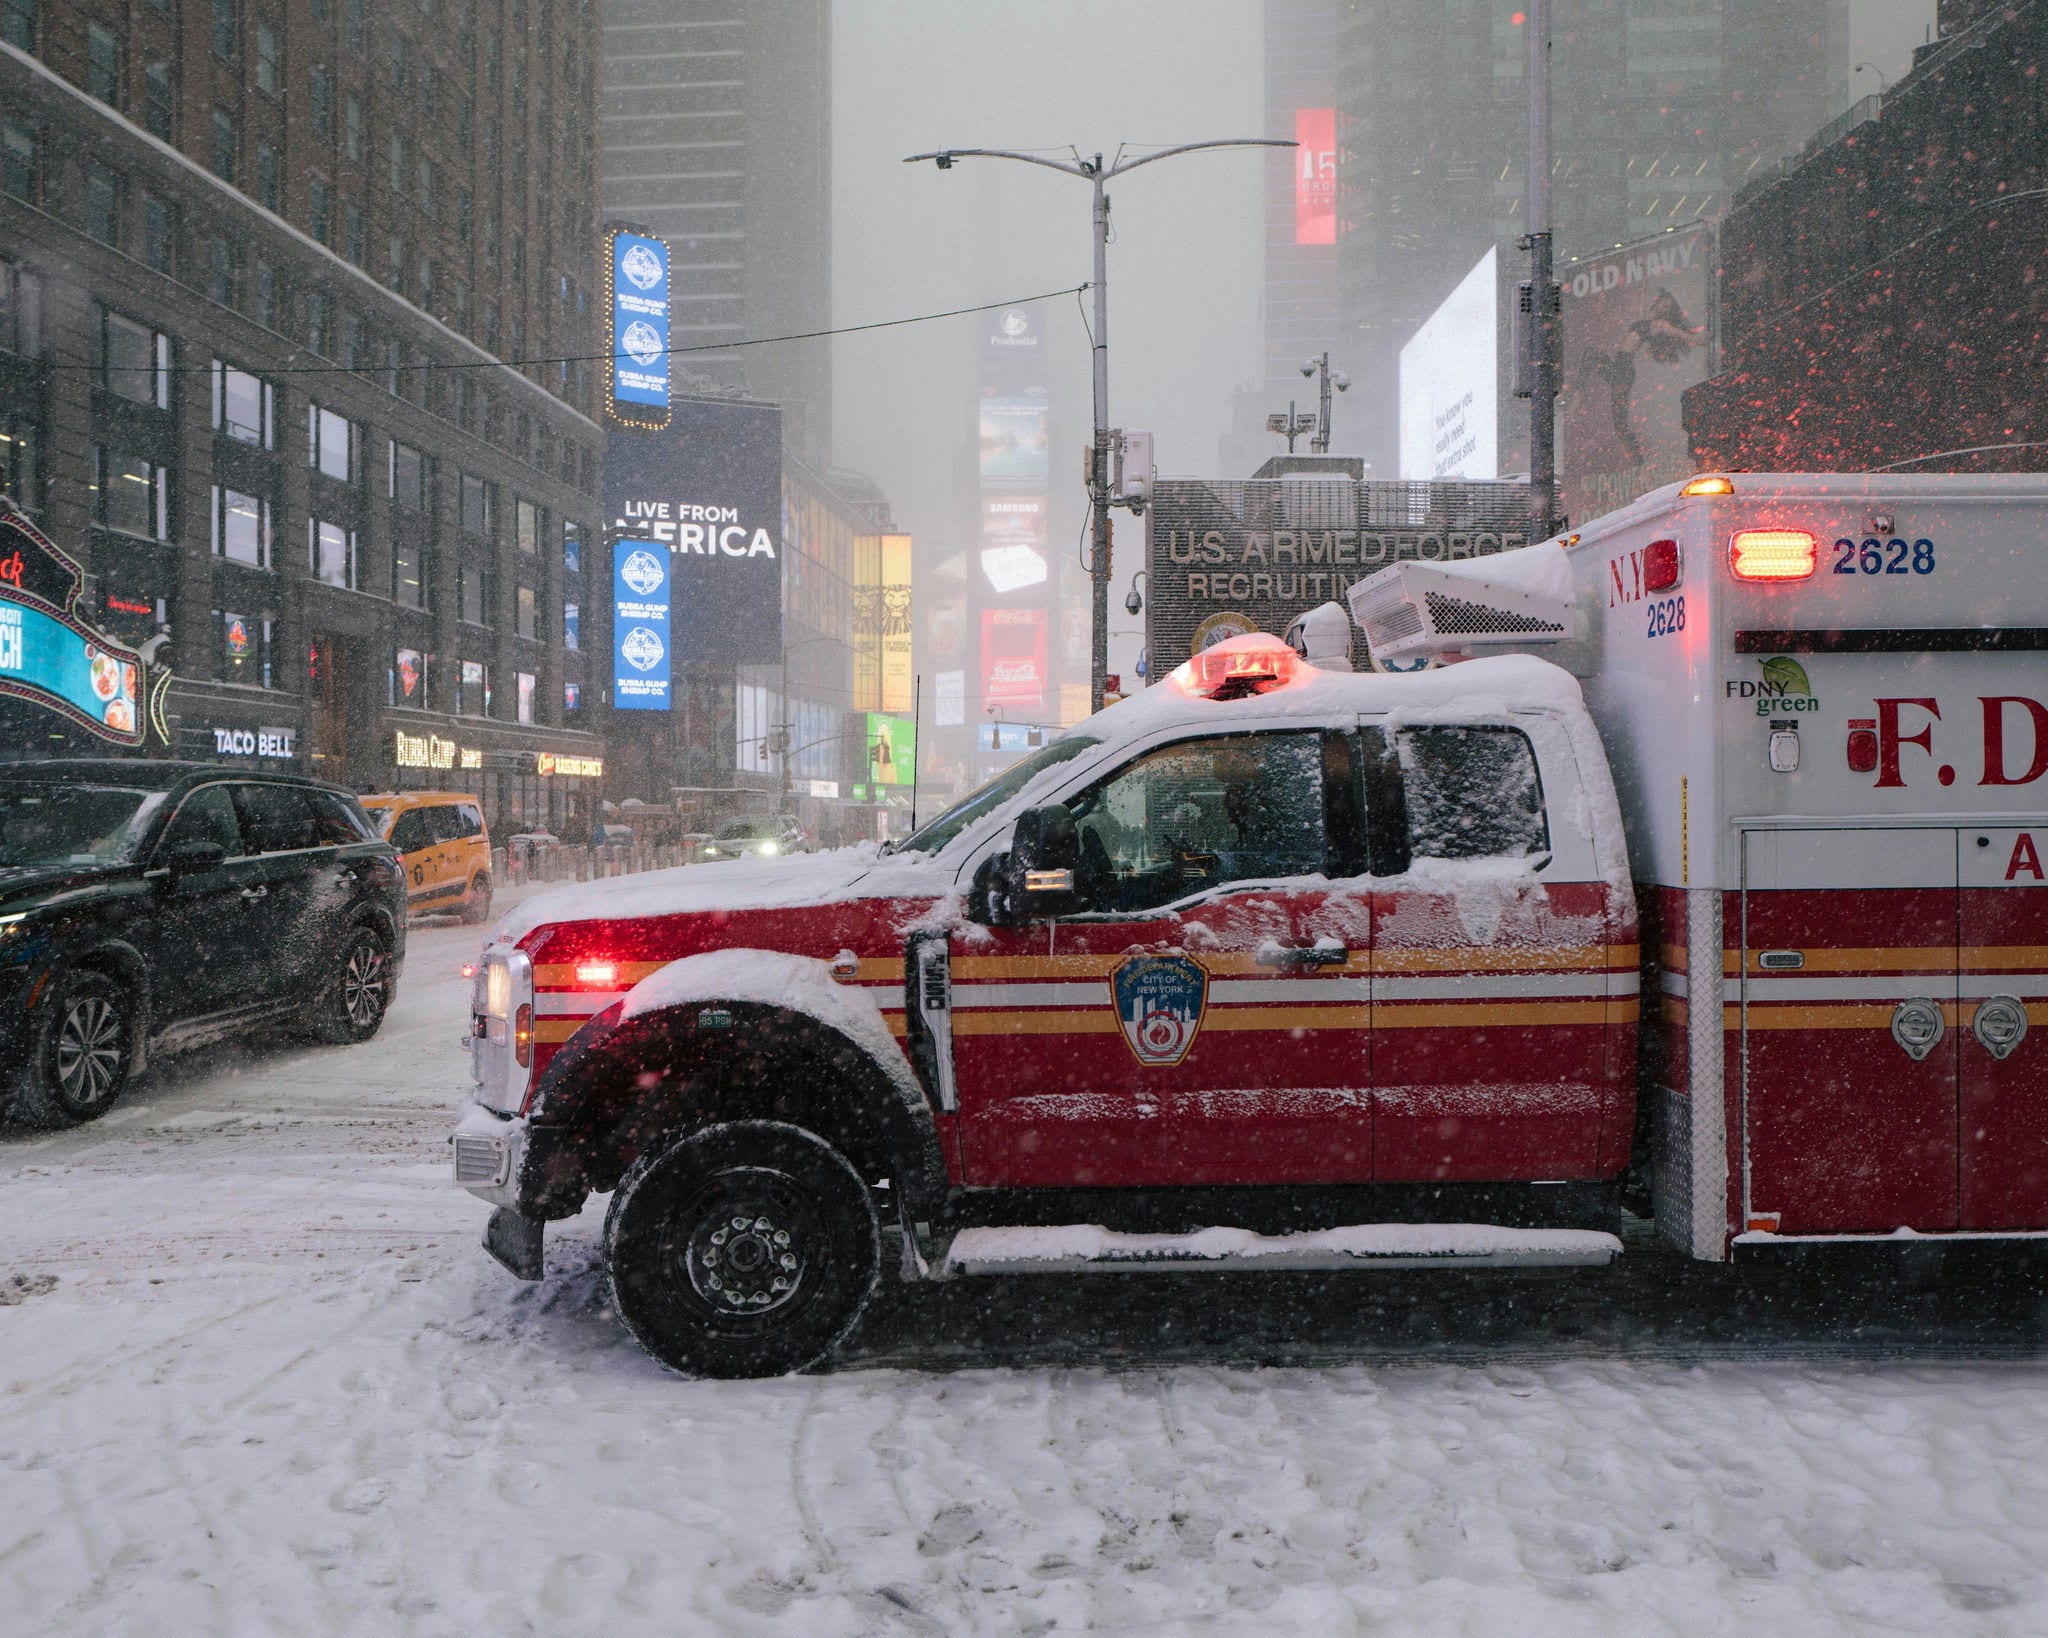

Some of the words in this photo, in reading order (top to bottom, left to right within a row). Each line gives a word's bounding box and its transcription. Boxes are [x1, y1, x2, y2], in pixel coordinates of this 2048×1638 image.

[1572, 264, 1620, 298] OLD
[1625, 243, 1694, 284] NAVY
[625, 501, 670, 519] LIVE
[679, 504, 738, 523] FROM
[990, 503, 1039, 513] SAMSUNG
[603, 519, 775, 559] ERICA
[1169, 530, 1234, 564] U.S.
[1240, 530, 1386, 566] ARMED
[1393, 532, 1529, 562] FORCE
[1832, 538, 1936, 575] 2628
[1188, 573, 1360, 600] RECRUITIN
[618, 602, 644, 611] BUBBA
[645, 603, 668, 614] GUMP
[621, 610, 650, 620] SHRIMP
[650, 611, 665, 620] CO.
[1647, 595, 1686, 639] 2628
[618, 679, 644, 688] BUBBA
[645, 679, 668, 689] GUMP
[621, 687, 650, 696] SHRIMP
[650, 687, 665, 696] CO.
[1726, 680, 1790, 698] FDNY
[1756, 697, 1819, 717] green
[214, 729, 255, 755] TACO
[258, 733, 293, 758] BELL
[1123, 972, 1140, 988] FIRE
[1141, 962, 1199, 986] DEPARTMENT
[1142, 975, 1162, 984] CITY
[1165, 975, 1178, 984] OF
[1137, 986, 1158, 994] NEW
[1159, 985, 1184, 994] YORK
